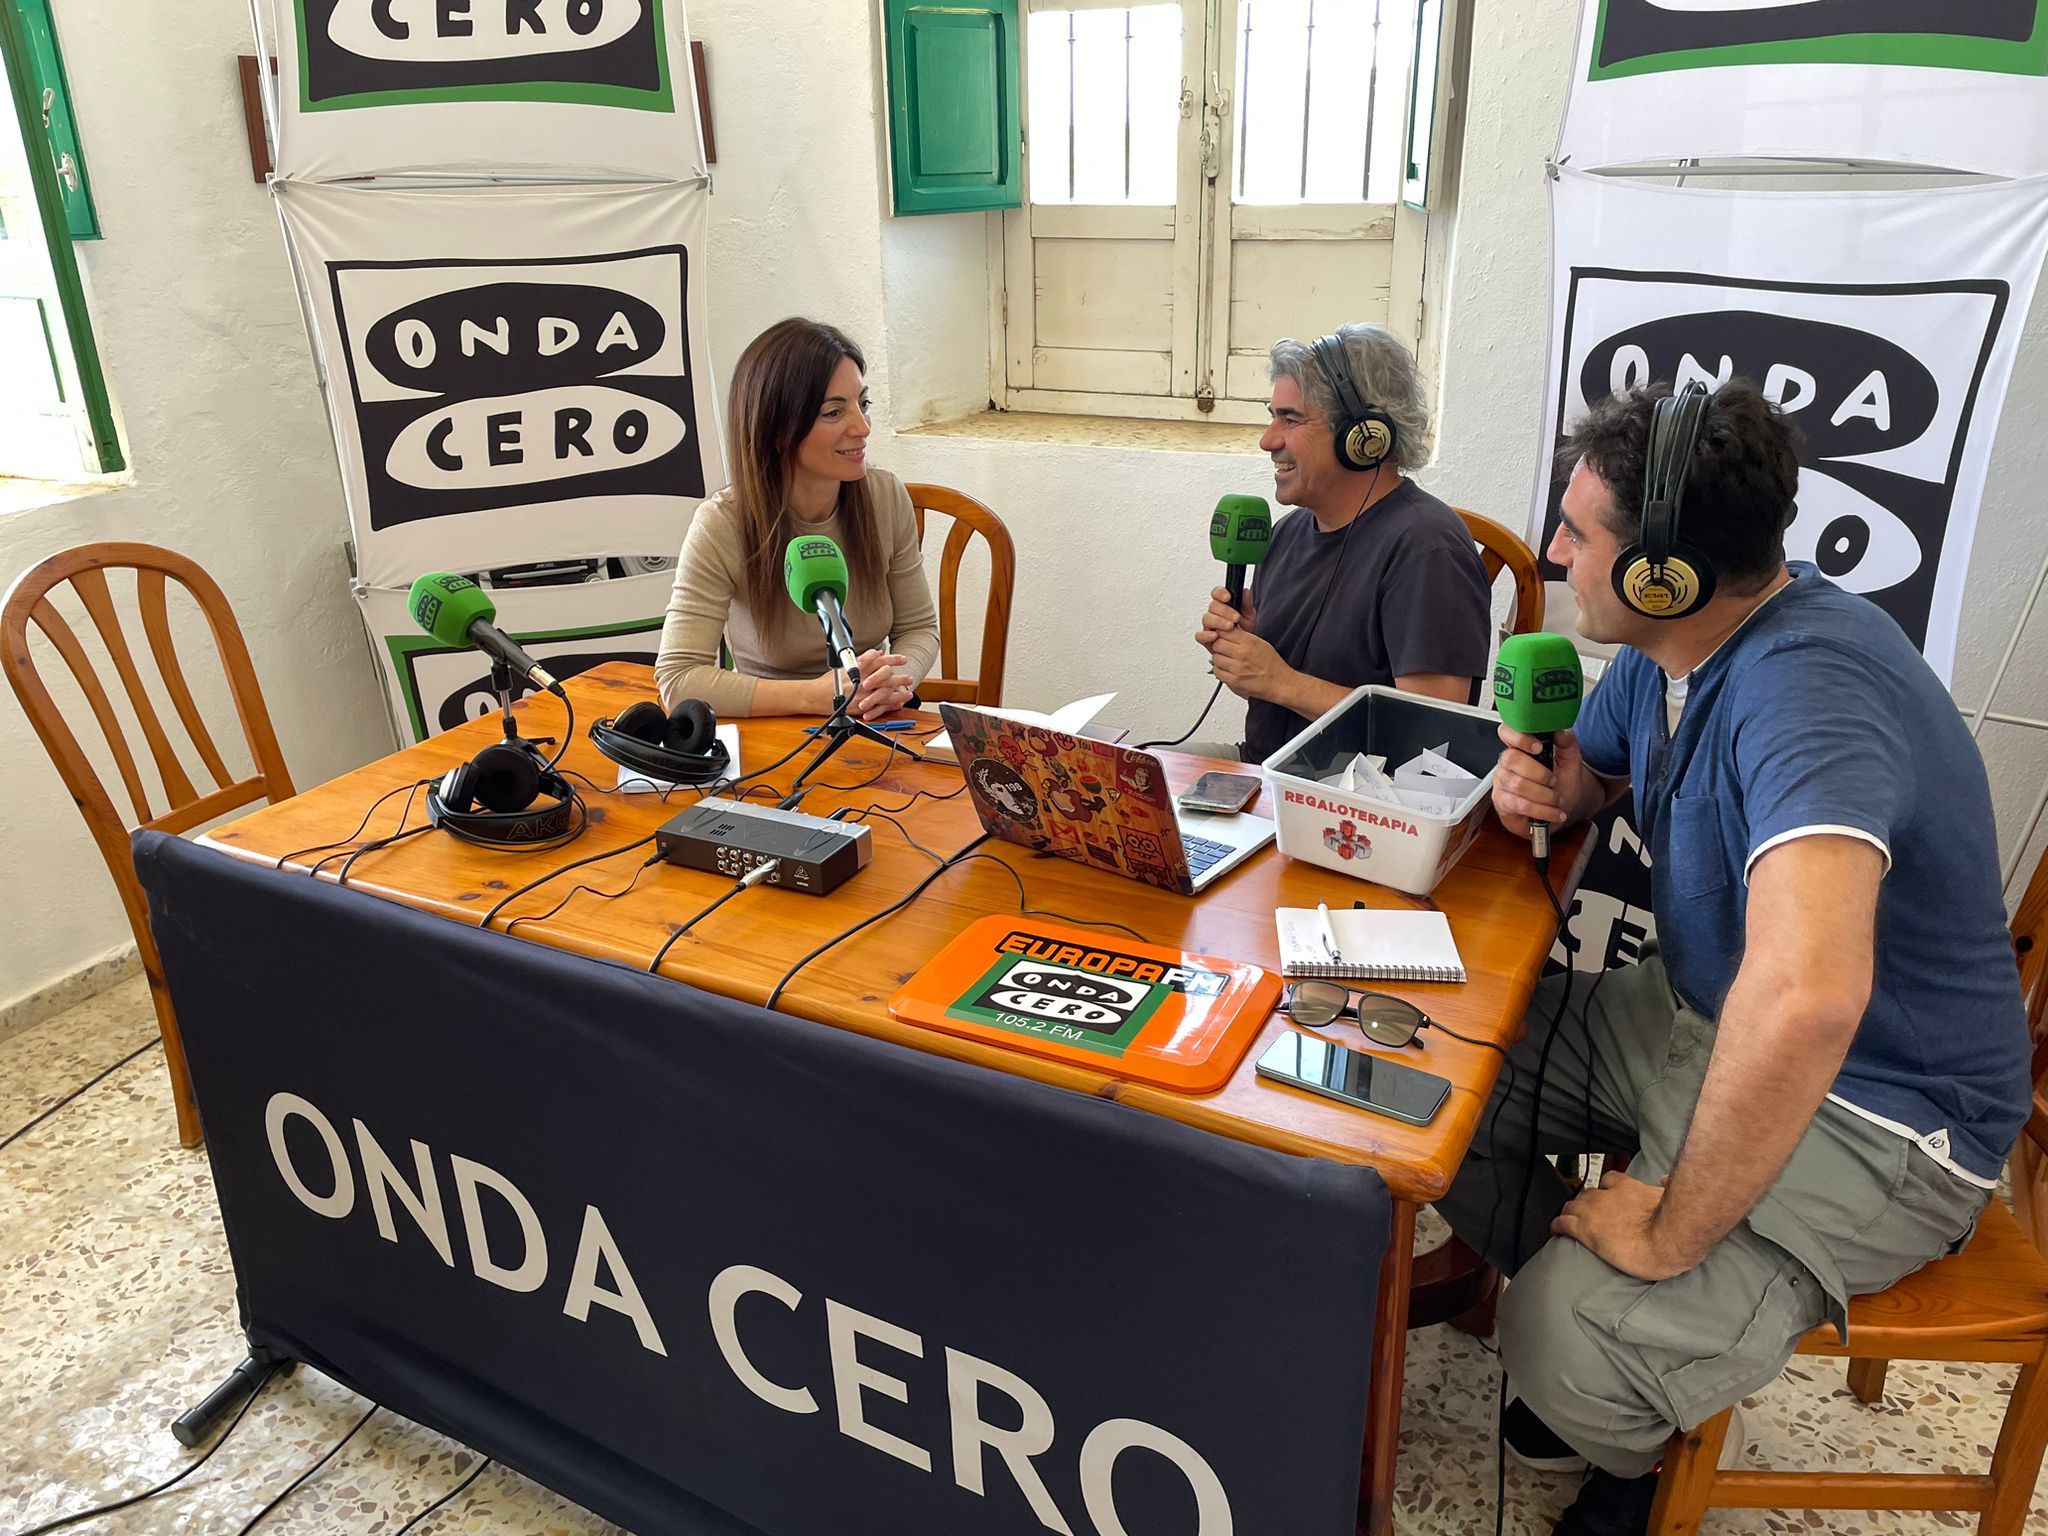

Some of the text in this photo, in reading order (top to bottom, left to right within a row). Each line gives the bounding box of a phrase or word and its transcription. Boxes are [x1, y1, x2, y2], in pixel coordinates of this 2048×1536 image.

[371, 0, 603, 40] CERO
[394, 310, 640, 370] ONDA
[425, 406, 649, 472] CERO
[1285, 790, 1419, 837] REGALOTERAPIA
[1009, 993, 1107, 1021] CERO
[1022, 973, 1120, 1003] ONDA
[995, 1012, 1085, 1042] 105.2 FM
[265, 1091, 1234, 1536] ONDA CERO
